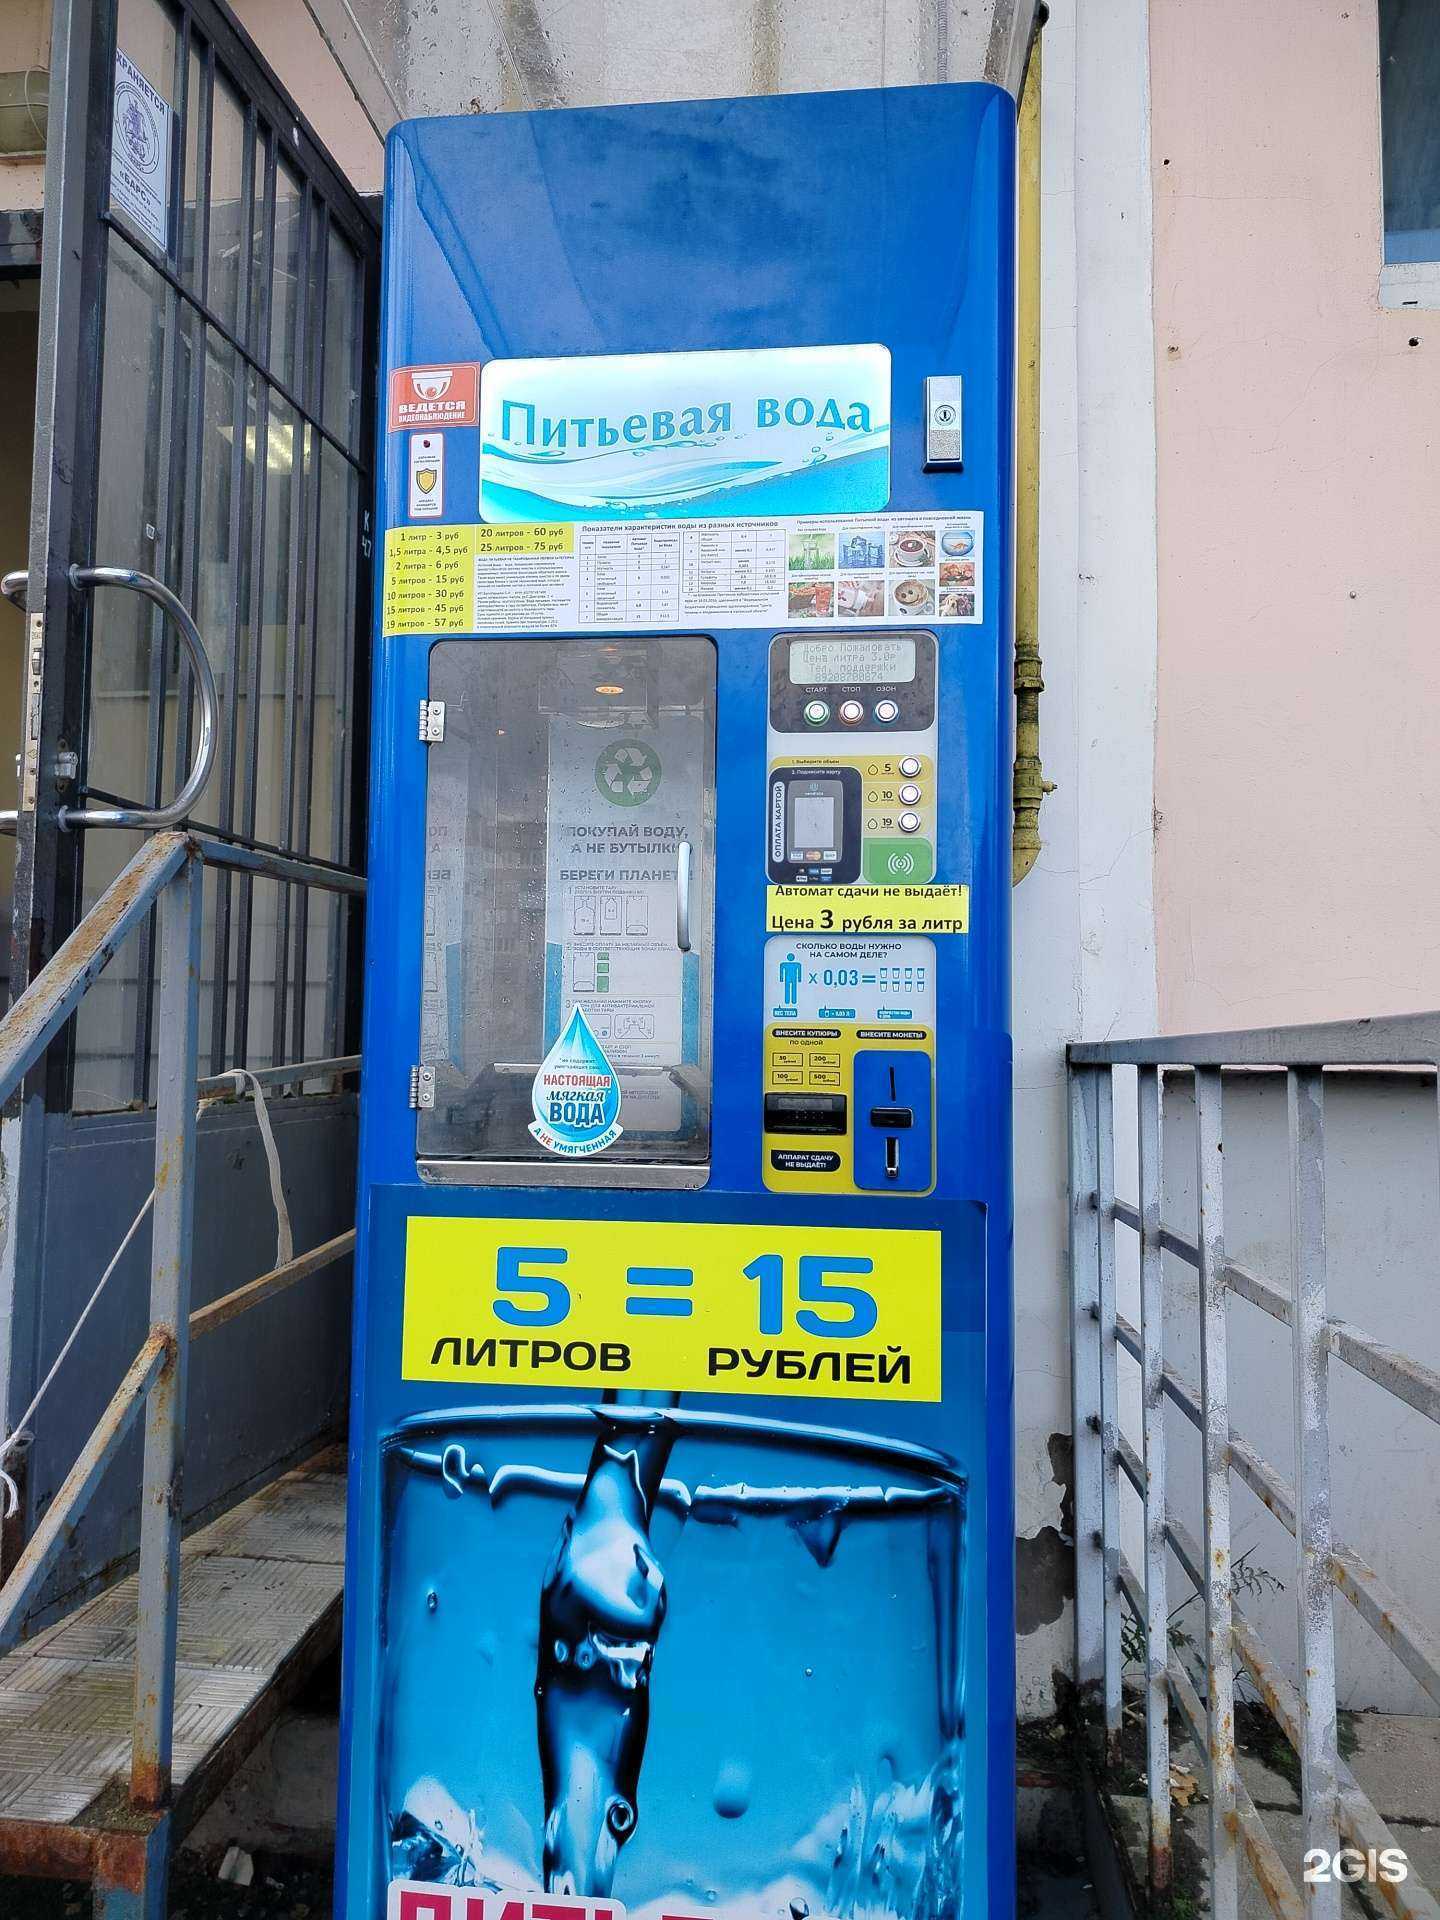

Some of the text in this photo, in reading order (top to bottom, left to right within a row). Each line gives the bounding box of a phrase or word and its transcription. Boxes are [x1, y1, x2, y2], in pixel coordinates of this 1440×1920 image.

[116, 53, 165, 116] ХРАНЯЕТСЯ
[399, 401, 466, 413] ВЕДЕТСЯ
[399, 412, 466, 423] ВИДЕОНАБЛЮДЕНИЕ
[502, 398, 873, 447] Питьевая вода
[401, 533, 406, 541] 1
[436, 532, 442, 540] 3
[445, 532, 459, 541] руб
[481, 529, 493, 537] 20
[534, 528, 546, 536] 60
[549, 527, 563, 536] руб
[390, 547, 402, 558] 1,5
[436, 546, 451, 555] 4,5
[454, 546, 468, 555] руб
[481, 543, 492, 552] 25
[534, 542, 546, 551] 75
[549, 542, 563, 552] руб
[396, 561, 459, 571] 2 литра 6 руб
[392, 577, 396, 585] 5
[436, 575, 447, 583] 15
[450, 576, 464, 585] руб
[388, 592, 396, 600] 10
[435, 590, 447, 598] 30
[450, 591, 464, 599] руб
[387, 606, 396, 614] 15
[435, 604, 447, 612] 45
[450, 605, 464, 613] руб
[387, 621, 395, 629] 19
[435, 618, 447, 627] 57
[449, 619, 464, 628] руб
[803, 651, 828, 663] Цена
[885, 764, 891, 772] 5
[882, 791, 893, 799] 10
[775, 785, 784, 858] ОПЛАТА КАРТОЙ
[882, 818, 892, 826] 19
[568, 824, 688, 839] ПОКУПАЙ ВОДУ,
[571, 843, 679, 853] А НЕ БУТЫЛК
[560, 870, 693, 880] БЕРЕГИ ПЛАНЕТ!
[775, 885, 962, 897] Автомат сдачи не выдаёт!
[772, 909, 962, 933] Цена 3 рубля за литр
[796, 942, 838, 950] СКОЛЬКО
[840, 943, 867, 951] ВОДЫ
[824, 951, 858, 959] САМОМ
[859, 951, 888, 959] ДЕЛЕ?
[823, 969, 859, 987] 0,03
[543, 1074, 611, 1088] НАСТОЯЩАЯ
[546, 1090, 605, 1102] мягкая
[550, 1102, 604, 1126] ВОДА
[533, 1127, 617, 1154] А НЕ УМЯГЧЕННАЯ
[796, 1161, 826, 1169] ВЫДАЁТ!
[492, 1246, 571, 1328] 5
[743, 1253, 879, 1339] 15
[430, 1337, 911, 1384] ЛИТРОВ РУБЛЕЙ
